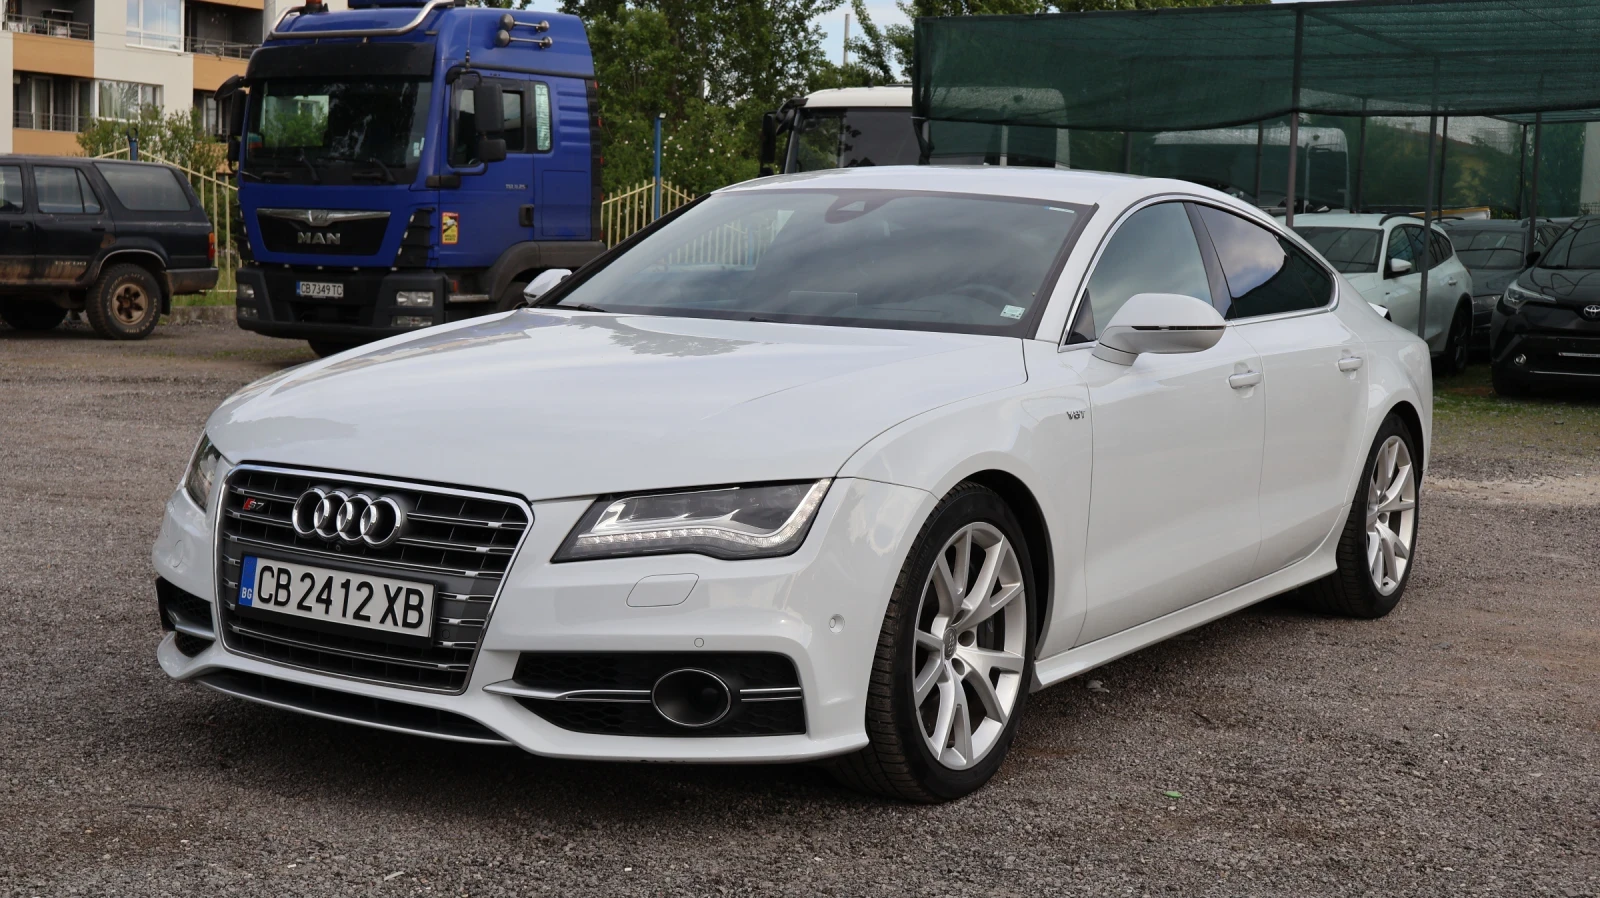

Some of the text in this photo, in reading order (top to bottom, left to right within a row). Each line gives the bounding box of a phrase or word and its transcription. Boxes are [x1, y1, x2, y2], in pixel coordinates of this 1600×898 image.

[297, 231, 341, 245] MAN
[301, 283, 311, 294] CB
[312, 284, 331, 295] 7349
[332, 285, 343, 296] TC
[248, 499, 265, 510] S7
[241, 587, 253, 600] BG
[257, 565, 424, 629] CB 2412 XB
